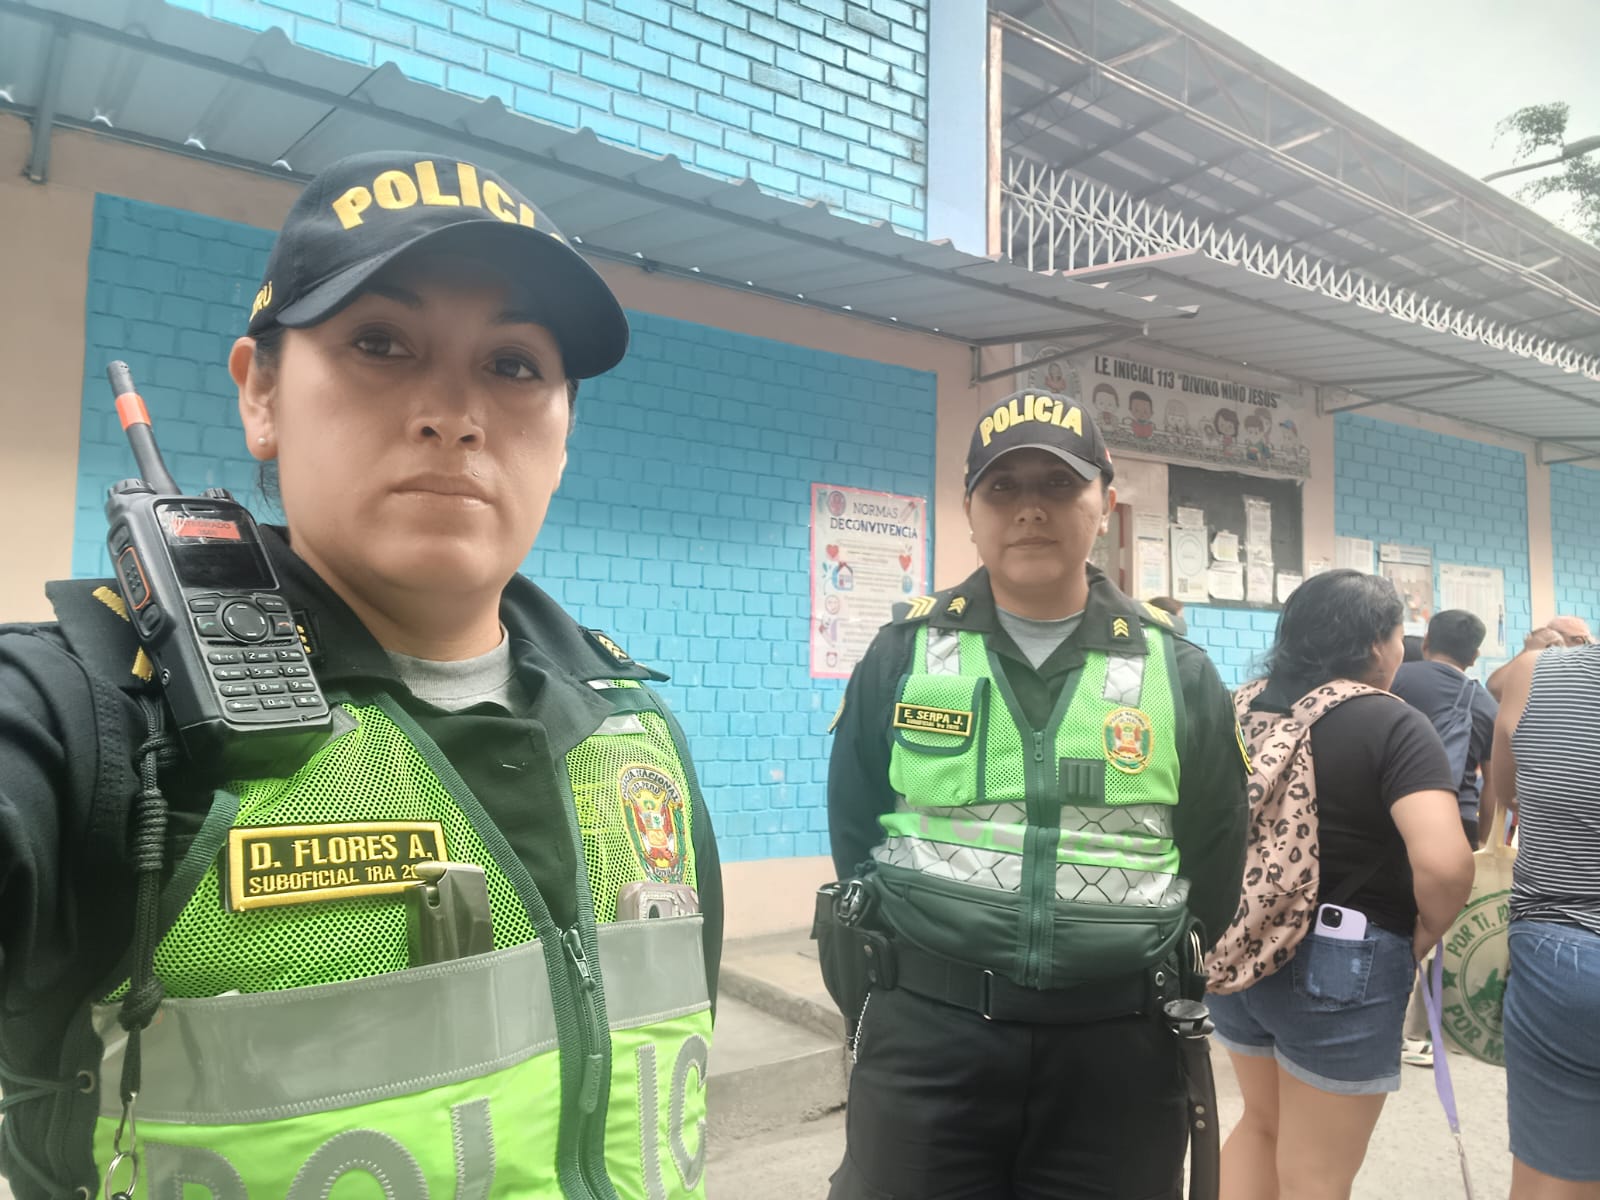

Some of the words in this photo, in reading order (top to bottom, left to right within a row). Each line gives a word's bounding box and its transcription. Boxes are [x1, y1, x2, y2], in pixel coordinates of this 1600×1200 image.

[332, 160, 564, 243] POLICI
[1114, 359, 1155, 385] INICIAL
[1157, 369, 1176, 390] 113
[852, 502, 899, 520] NORMAS
[916, 710, 950, 724] SERPA
[952, 715, 964, 726] J.
[250, 842, 282, 871] D.
[293, 833, 398, 867] FLORES
[408, 833, 433, 858] A.
[249, 865, 360, 894] SUBOFICIAL
[366, 865, 396, 882] 1RA
[1446, 926, 1475, 958] POR
[1444, 1004, 1482, 1044] POR
